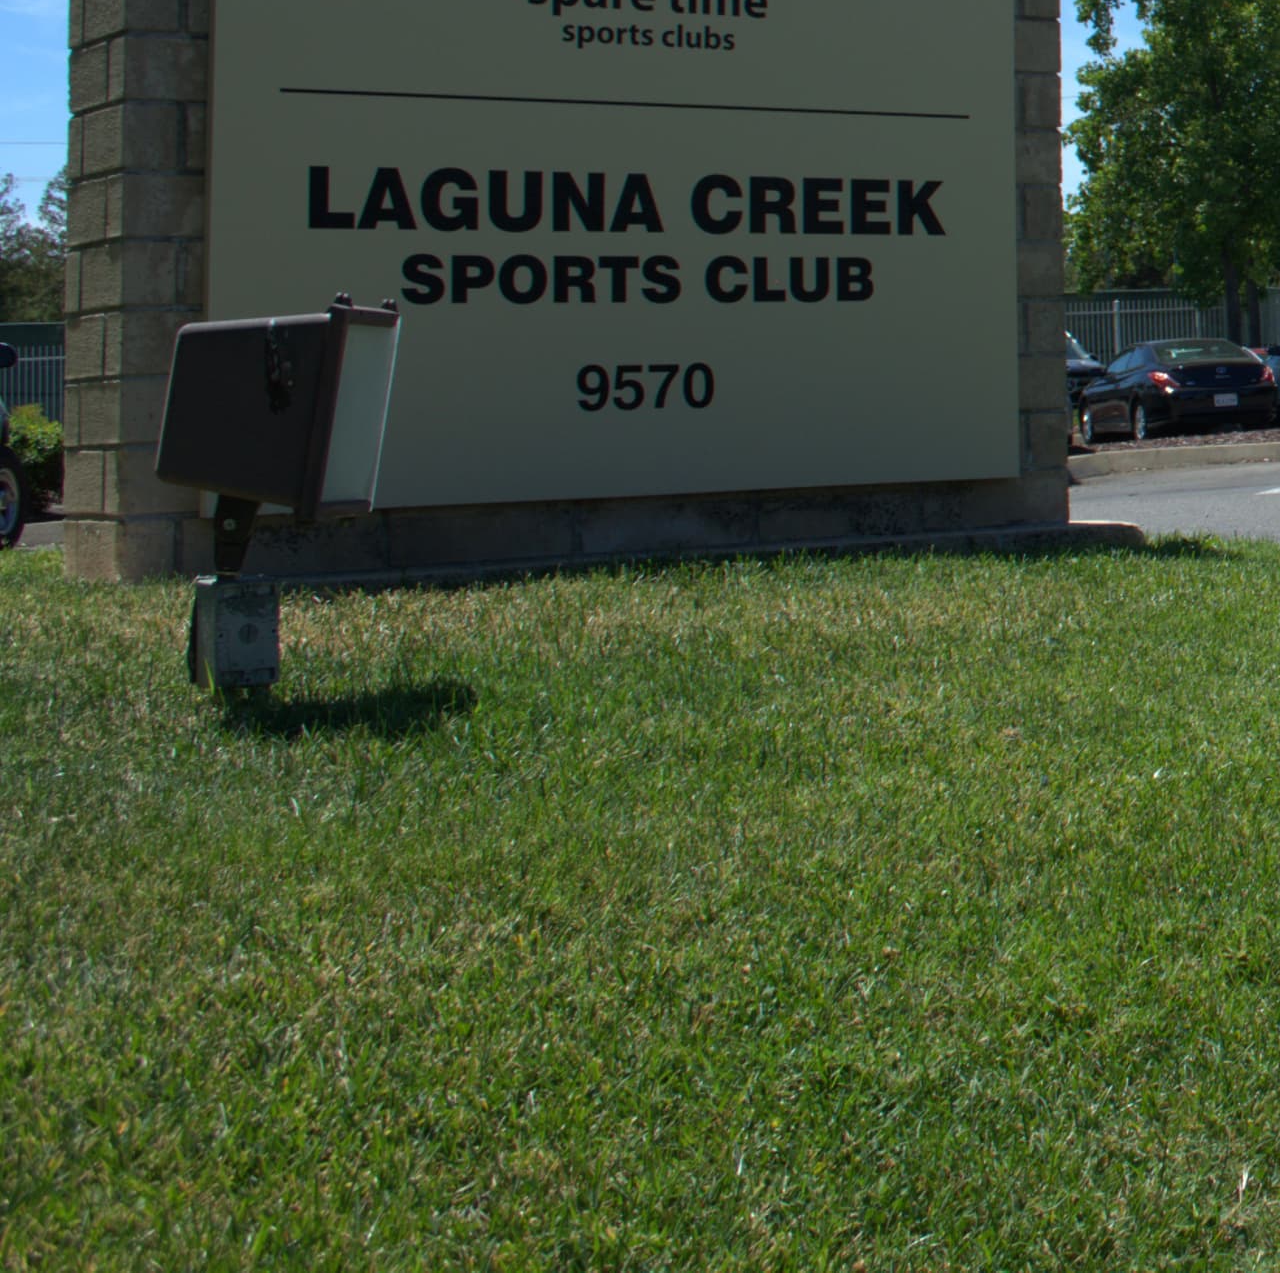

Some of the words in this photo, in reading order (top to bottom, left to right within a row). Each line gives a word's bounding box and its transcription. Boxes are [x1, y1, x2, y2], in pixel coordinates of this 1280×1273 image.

[561, 22, 655, 50] sports
[660, 23, 736, 52] clubs
[307, 164, 665, 234] LAGUNA
[690, 173, 947, 237] CREEK
[400, 252, 683, 306] SPORTS
[703, 253, 875, 305] CLUB
[575, 361, 716, 414] 9570
